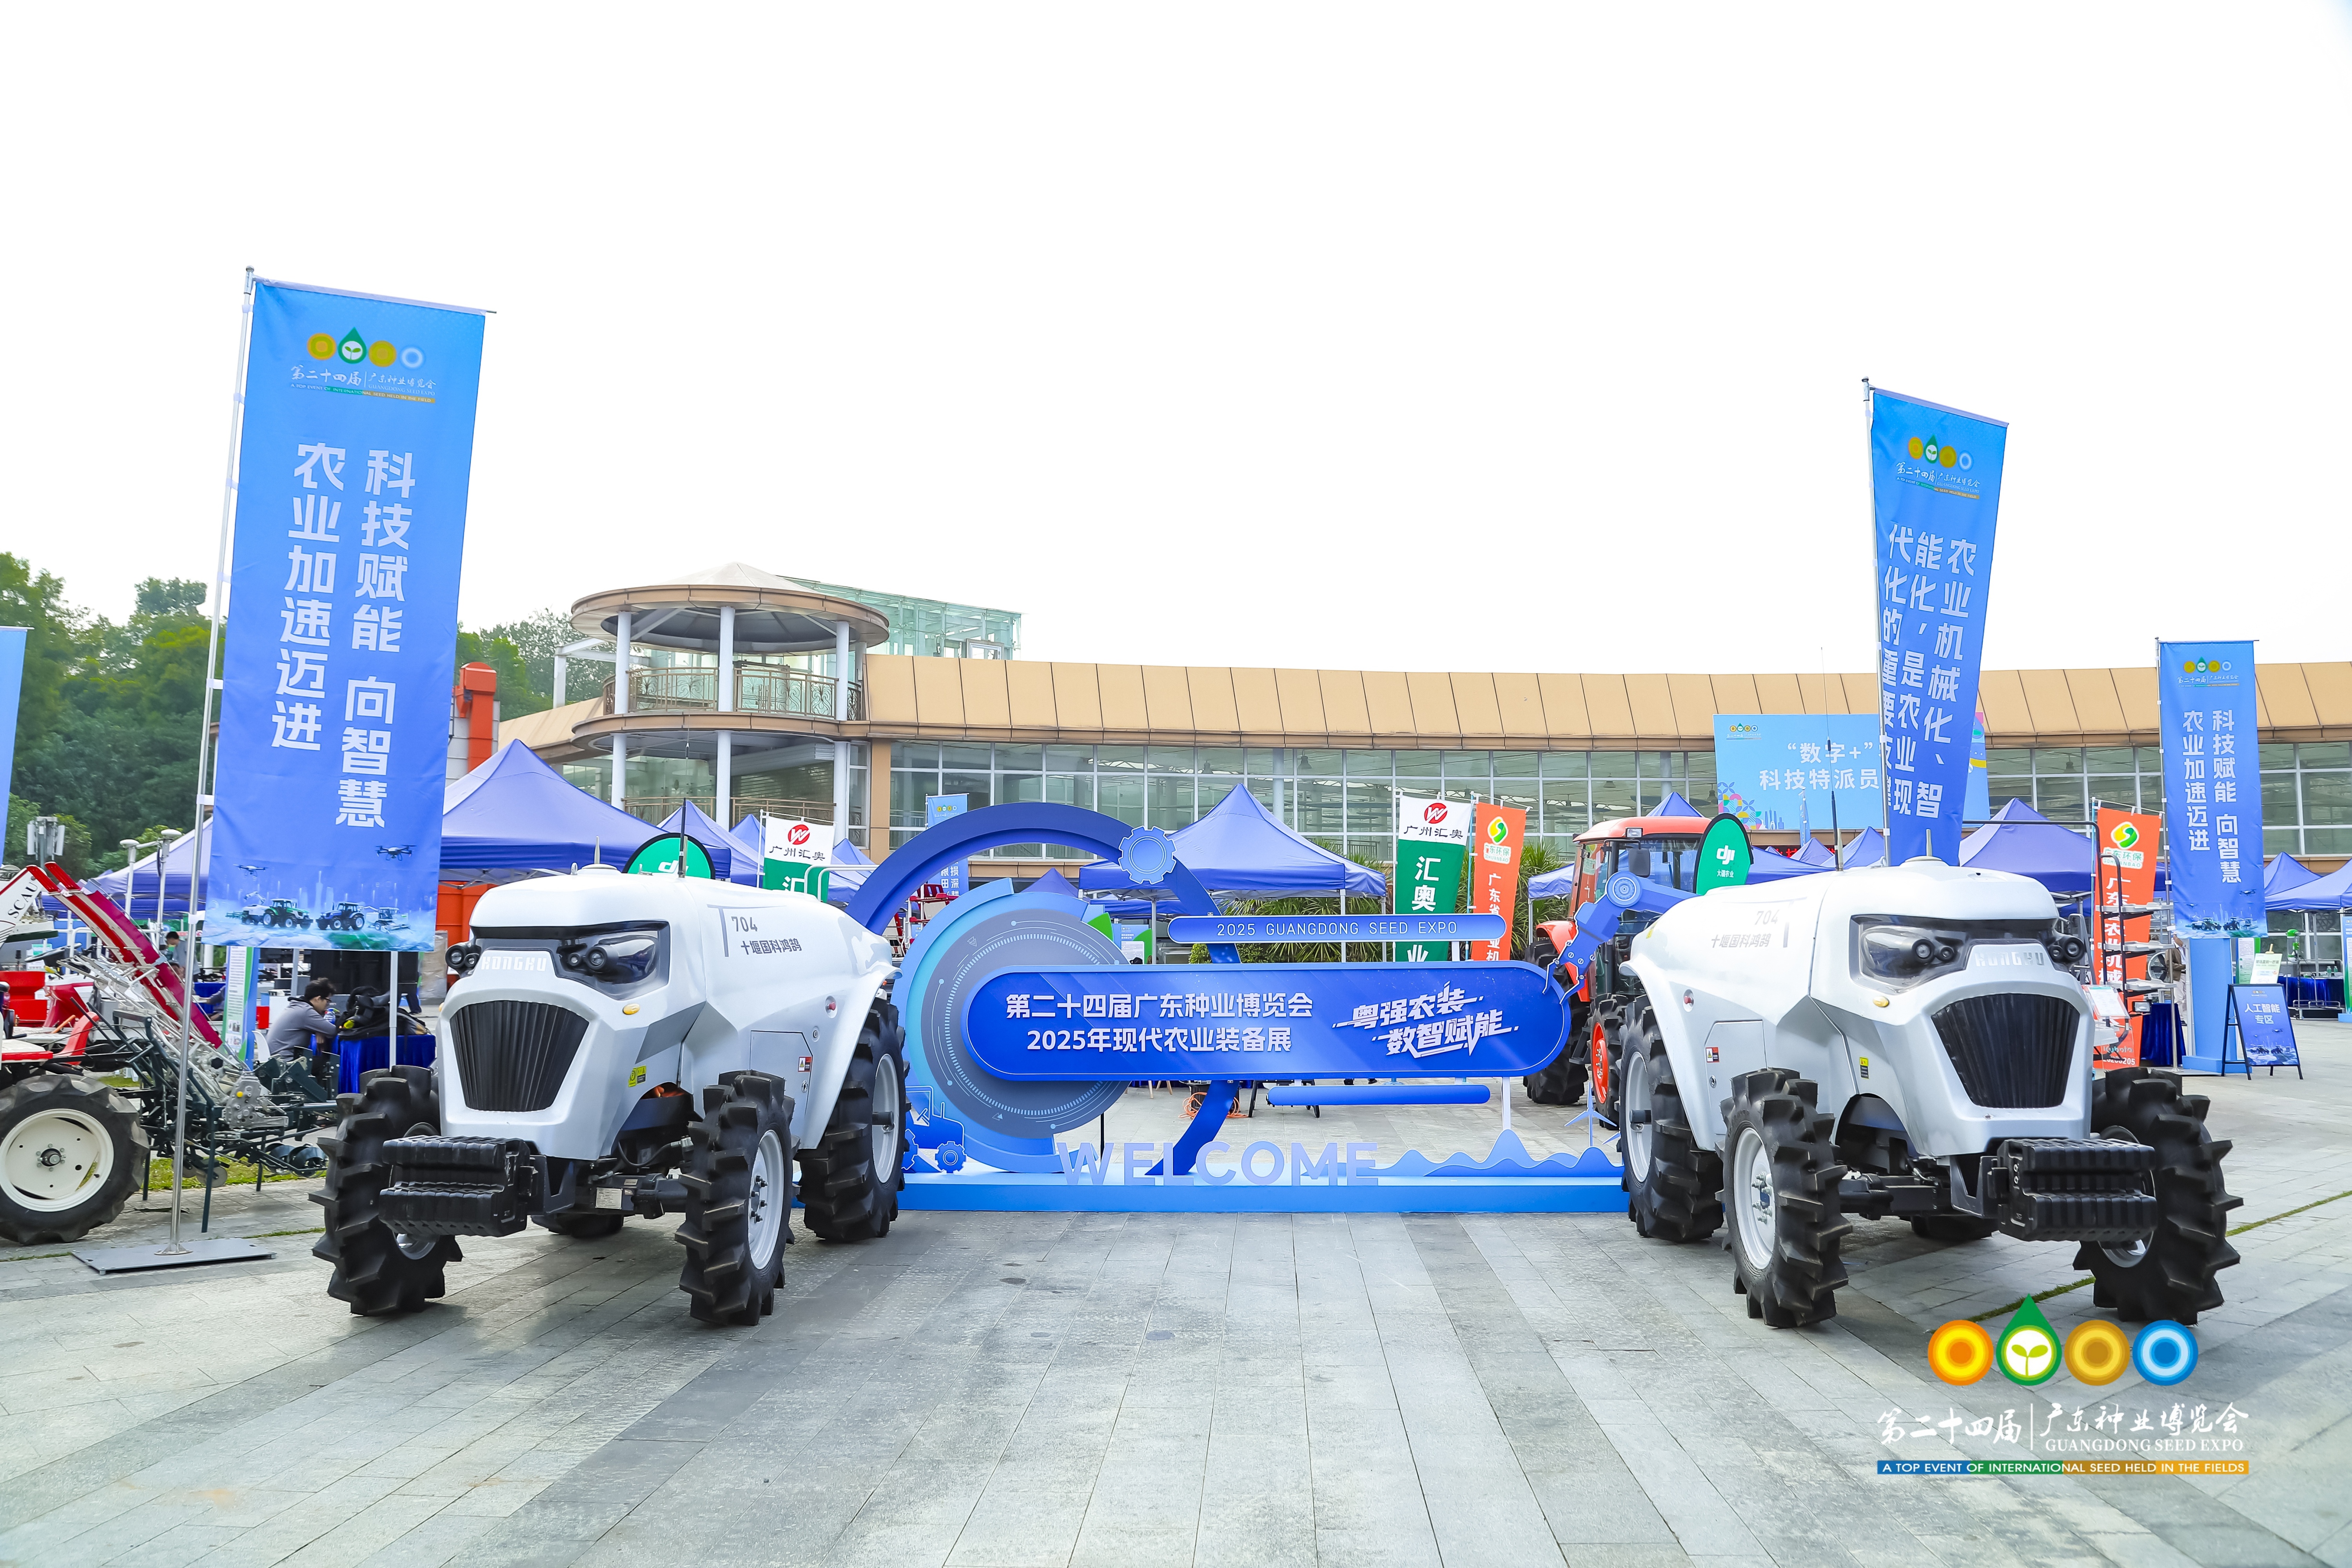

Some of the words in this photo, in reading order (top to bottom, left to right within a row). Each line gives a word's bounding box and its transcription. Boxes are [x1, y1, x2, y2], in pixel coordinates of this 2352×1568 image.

[290, 364, 362, 386] 第二十四届
[1896, 461, 1935, 482] 第二十四届
[352, 449, 416, 653] 科技赋能
[271, 442, 346, 750] 农业加速迈进
[335, 675, 396, 828] 向智慧
[2212, 710, 2237, 803] 科技赋能
[1759, 768, 1879, 790] 科技特派员
[2183, 710, 2210, 851] 农业加速迈进
[1404, 825, 1463, 839] 广州汇奥
[769, 846, 825, 861] 广州汇奥
[1485, 844, 1509, 856] 广东环保
[2105, 849, 2141, 861] 广东环保
[2216, 813, 2241, 884] 向智慧
[8, 882, 38, 918] SCAU
[731, 916, 757, 932] 704
[1755, 909, 1779, 925] 704
[1217, 924, 1256, 936] 2025
[1266, 922, 1359, 935] GUANGDONG
[1369, 922, 1408, 935] SEED
[1418, 921, 1457, 934] EXPO
[740, 938, 802, 955] 十堰国科鸿鹄
[1711, 933, 1771, 948] 十堰国科鸿鹄
[1006, 993, 1313, 1018] 第二十四届广东种业博览会
[1332, 980, 1483, 1029] 粤强农装
[2245, 1004, 2281, 1013] 人工智能
[2255, 1015, 2274, 1024] 专区
[1027, 1027, 1292, 1052] 2025年现代农业装备展
[1372, 1009, 1519, 1058] 数智赋能
[1058, 1141, 1378, 1187] WELCOME
